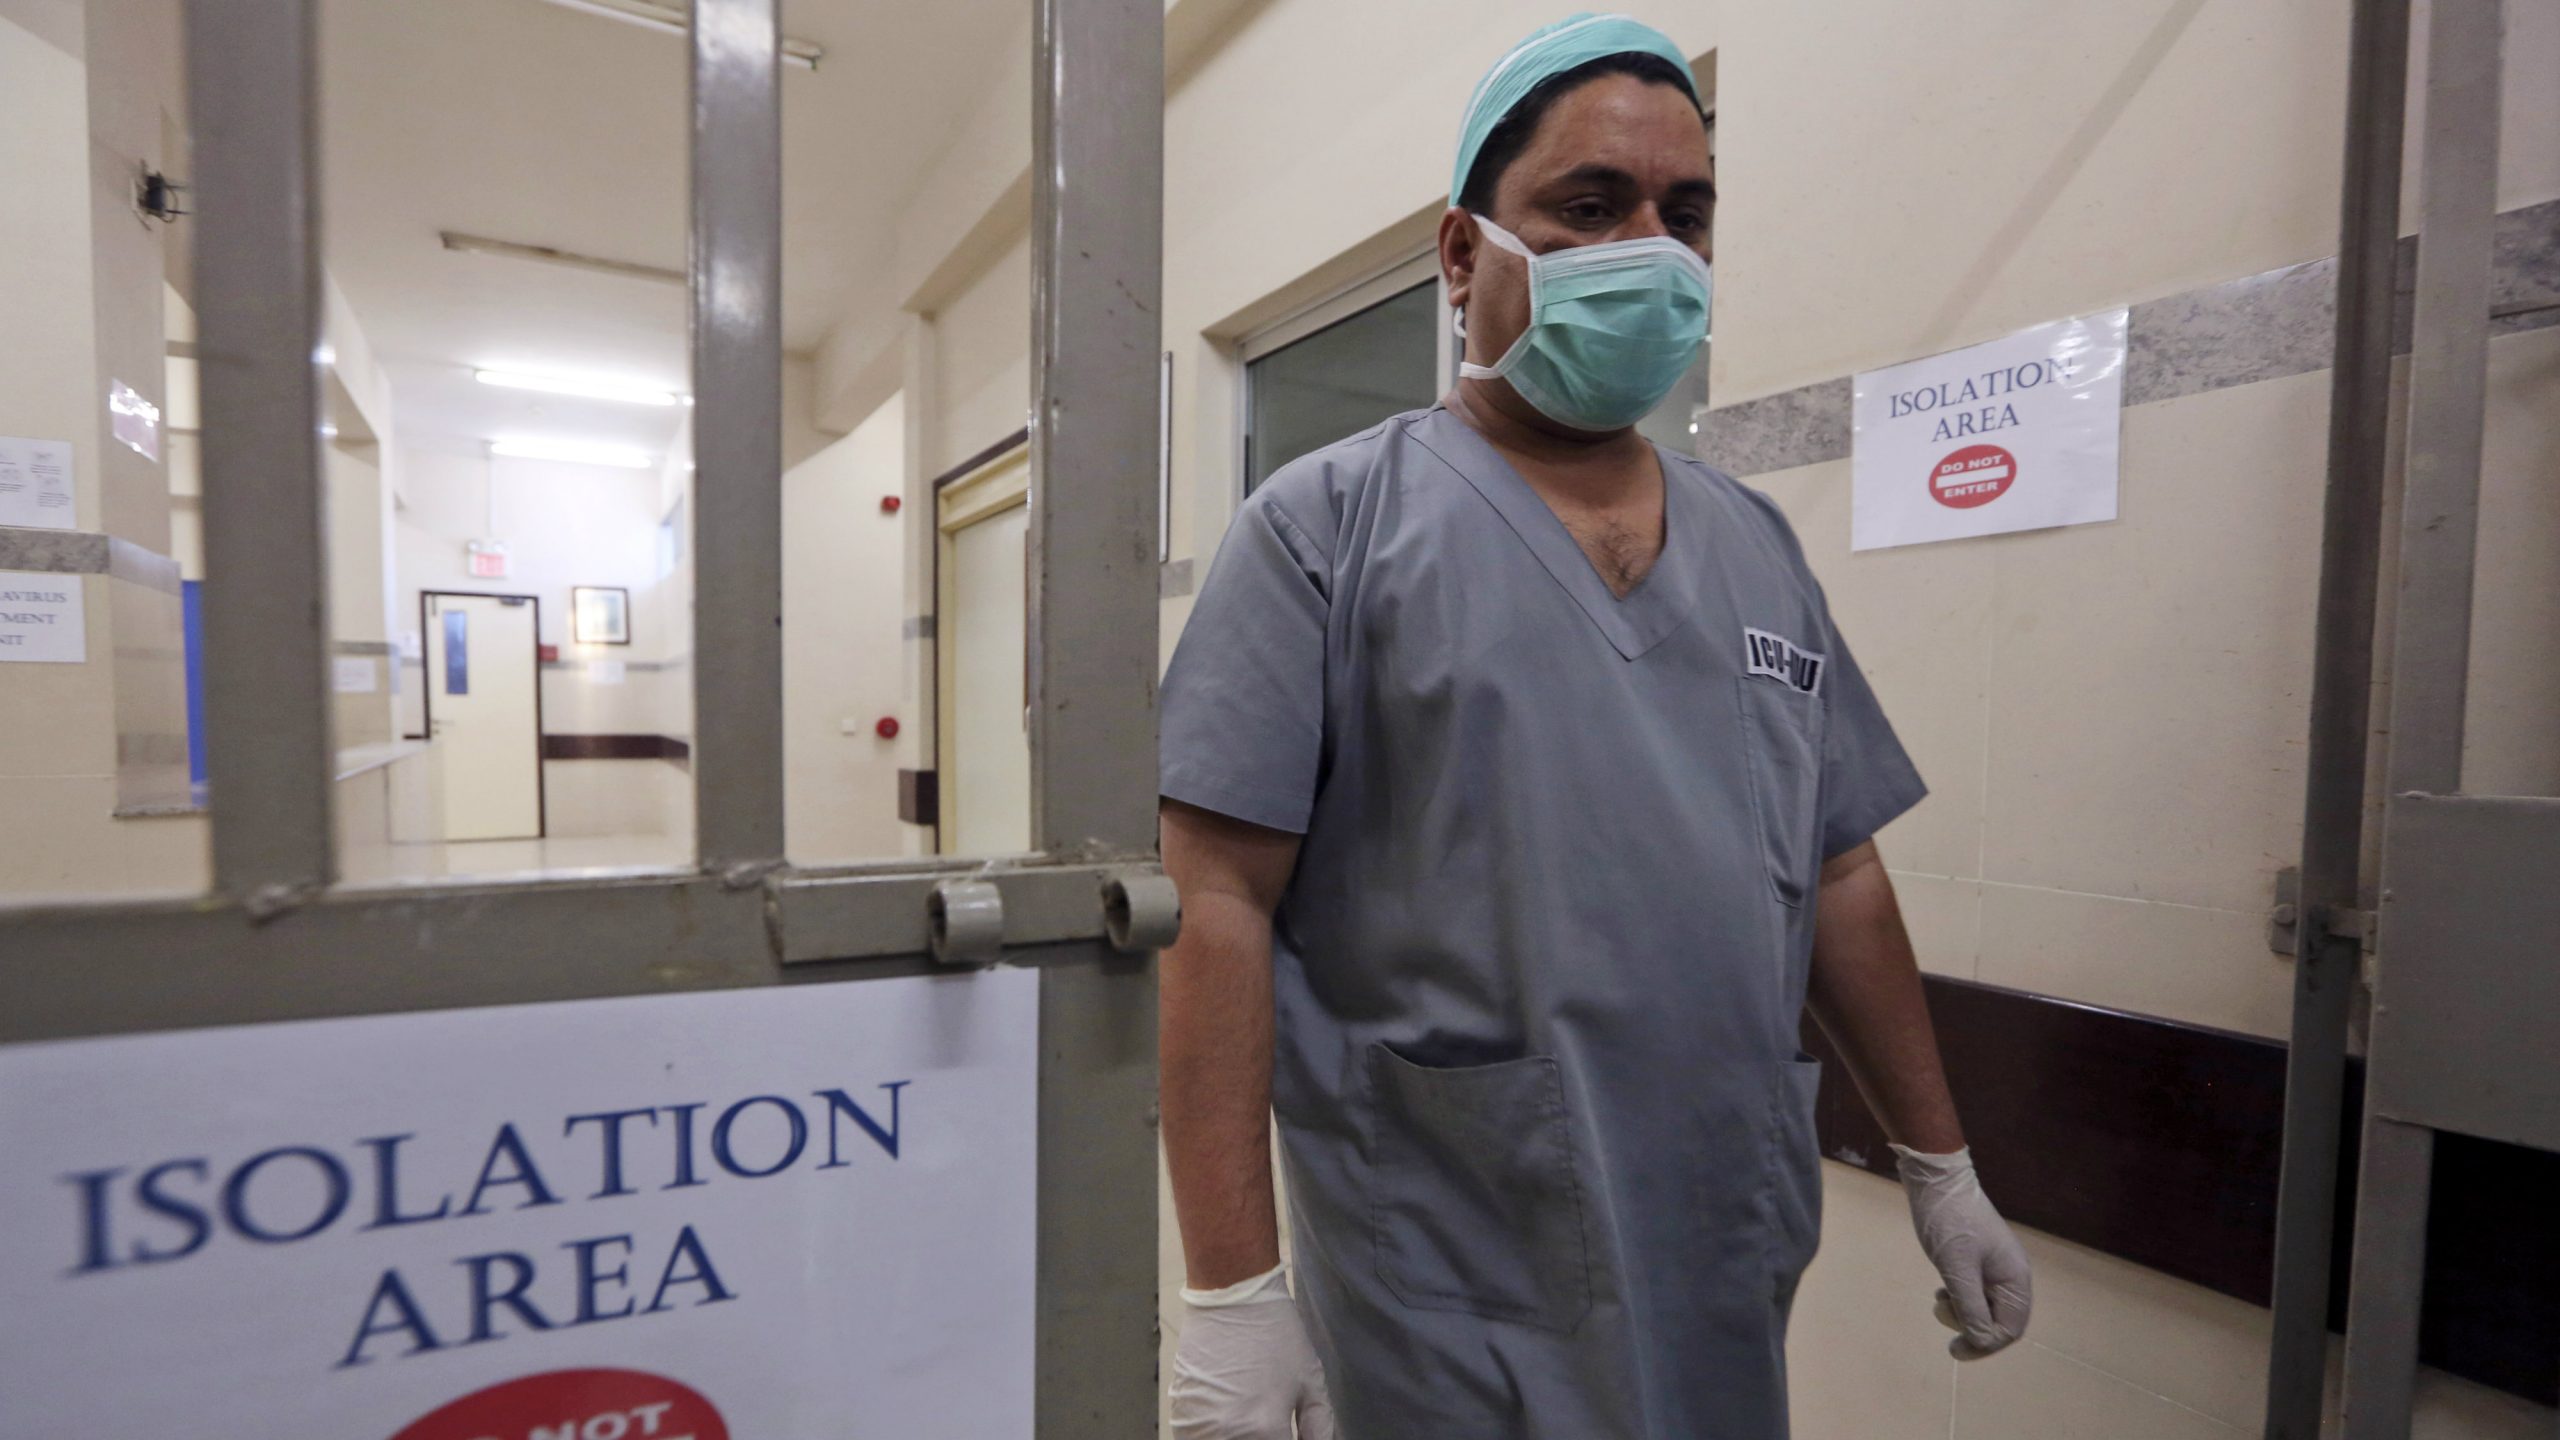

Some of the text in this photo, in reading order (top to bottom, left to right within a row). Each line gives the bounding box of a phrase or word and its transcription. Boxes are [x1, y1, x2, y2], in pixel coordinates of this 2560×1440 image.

[1889, 357, 2073, 418] ISOLATION
[1931, 402, 2020, 442] AREA
[1941, 454, 2004, 474] DO NOT
[1944, 481, 1999, 498] ENTER
[0, 612, 58, 625] MENT
[60, 1080, 912, 1278] ISOLATION
[332, 1224, 740, 1370] AREA
